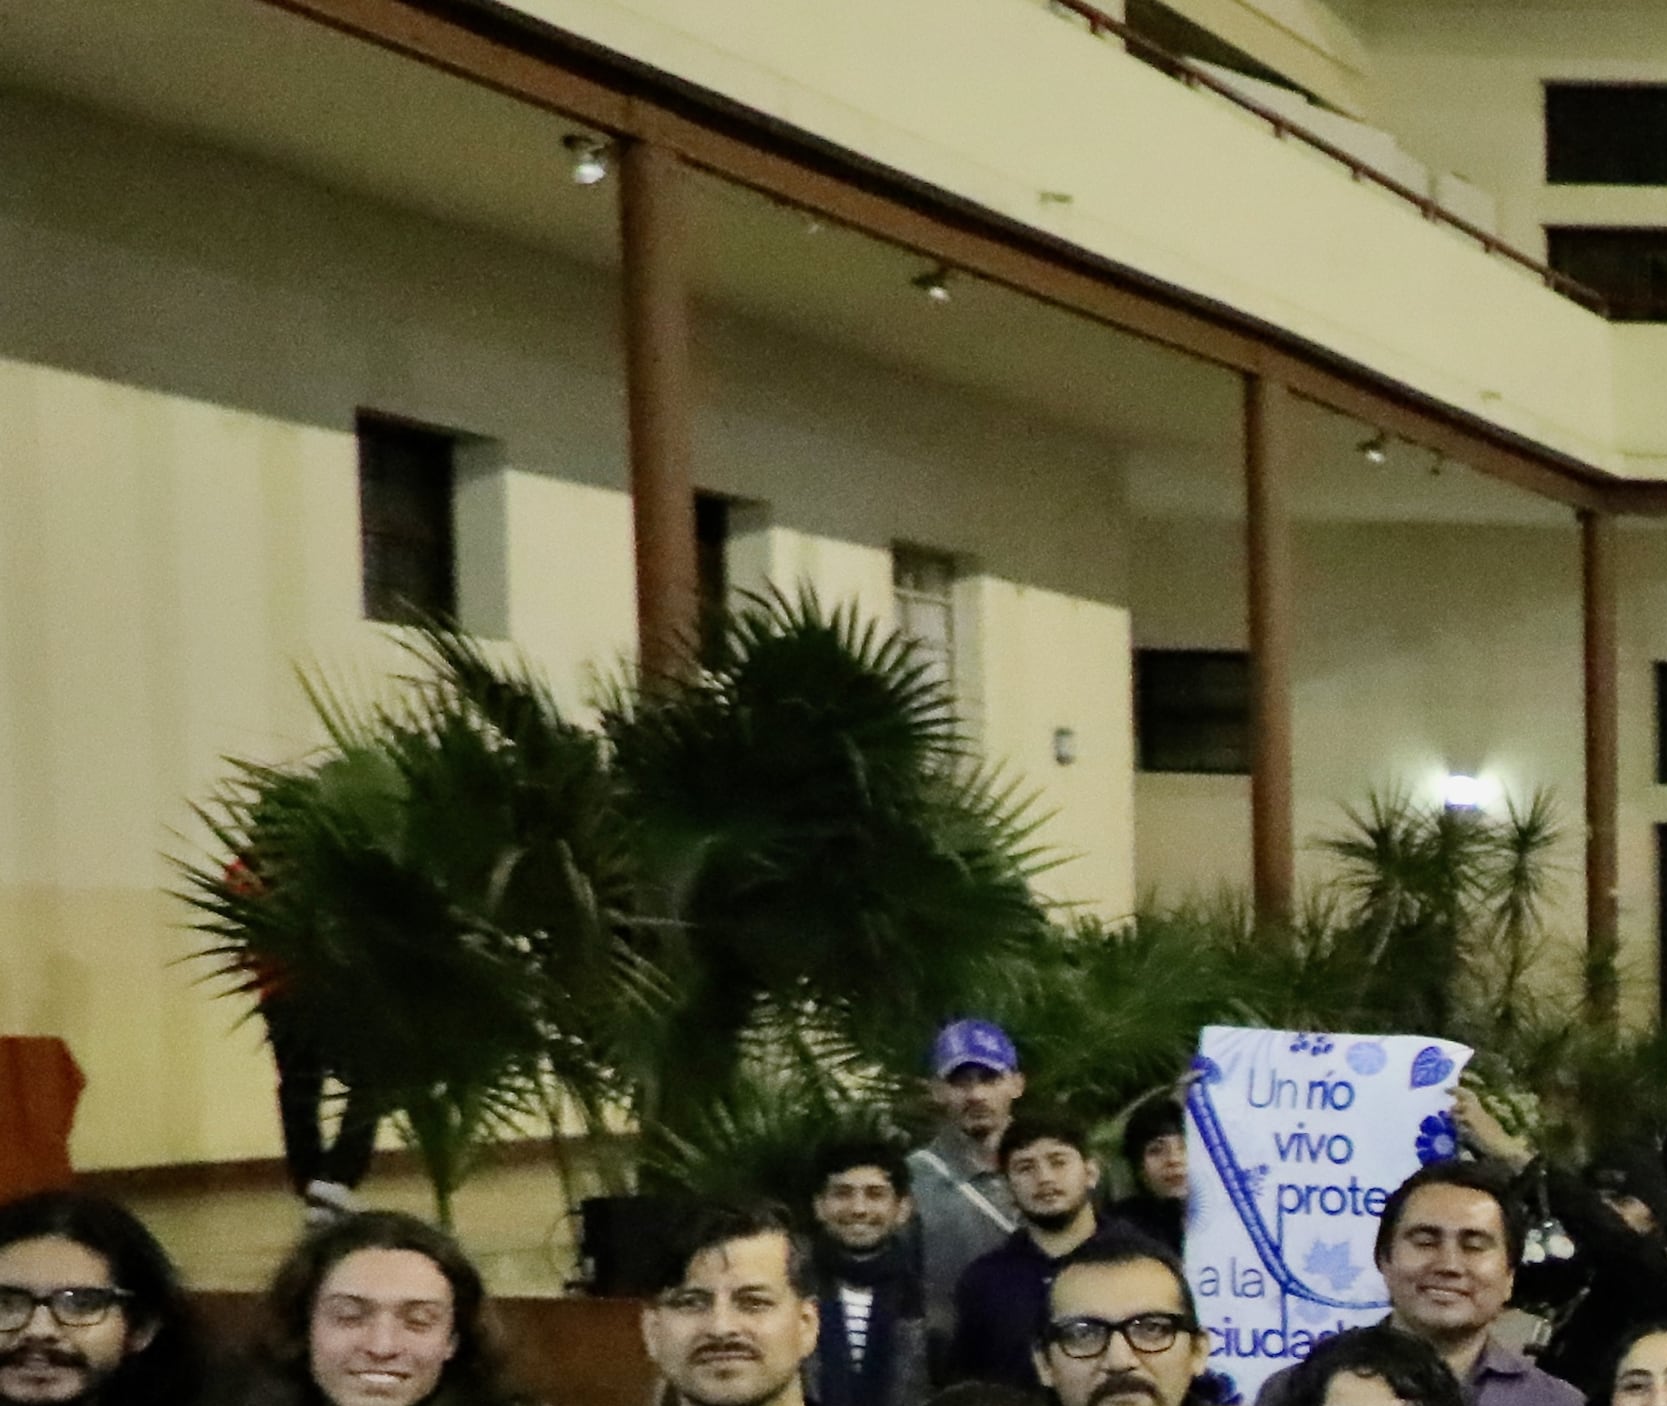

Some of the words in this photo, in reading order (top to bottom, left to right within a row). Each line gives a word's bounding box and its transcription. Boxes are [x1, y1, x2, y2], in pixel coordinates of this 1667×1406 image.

[1247, 1068, 1297, 1109] Un
[1305, 1071, 1355, 1112] río
[1274, 1122, 1354, 1166] vivo
[1278, 1177, 1387, 1224] prote
[1200, 1264, 1219, 1296] a
[1231, 1257, 1265, 1298] la
